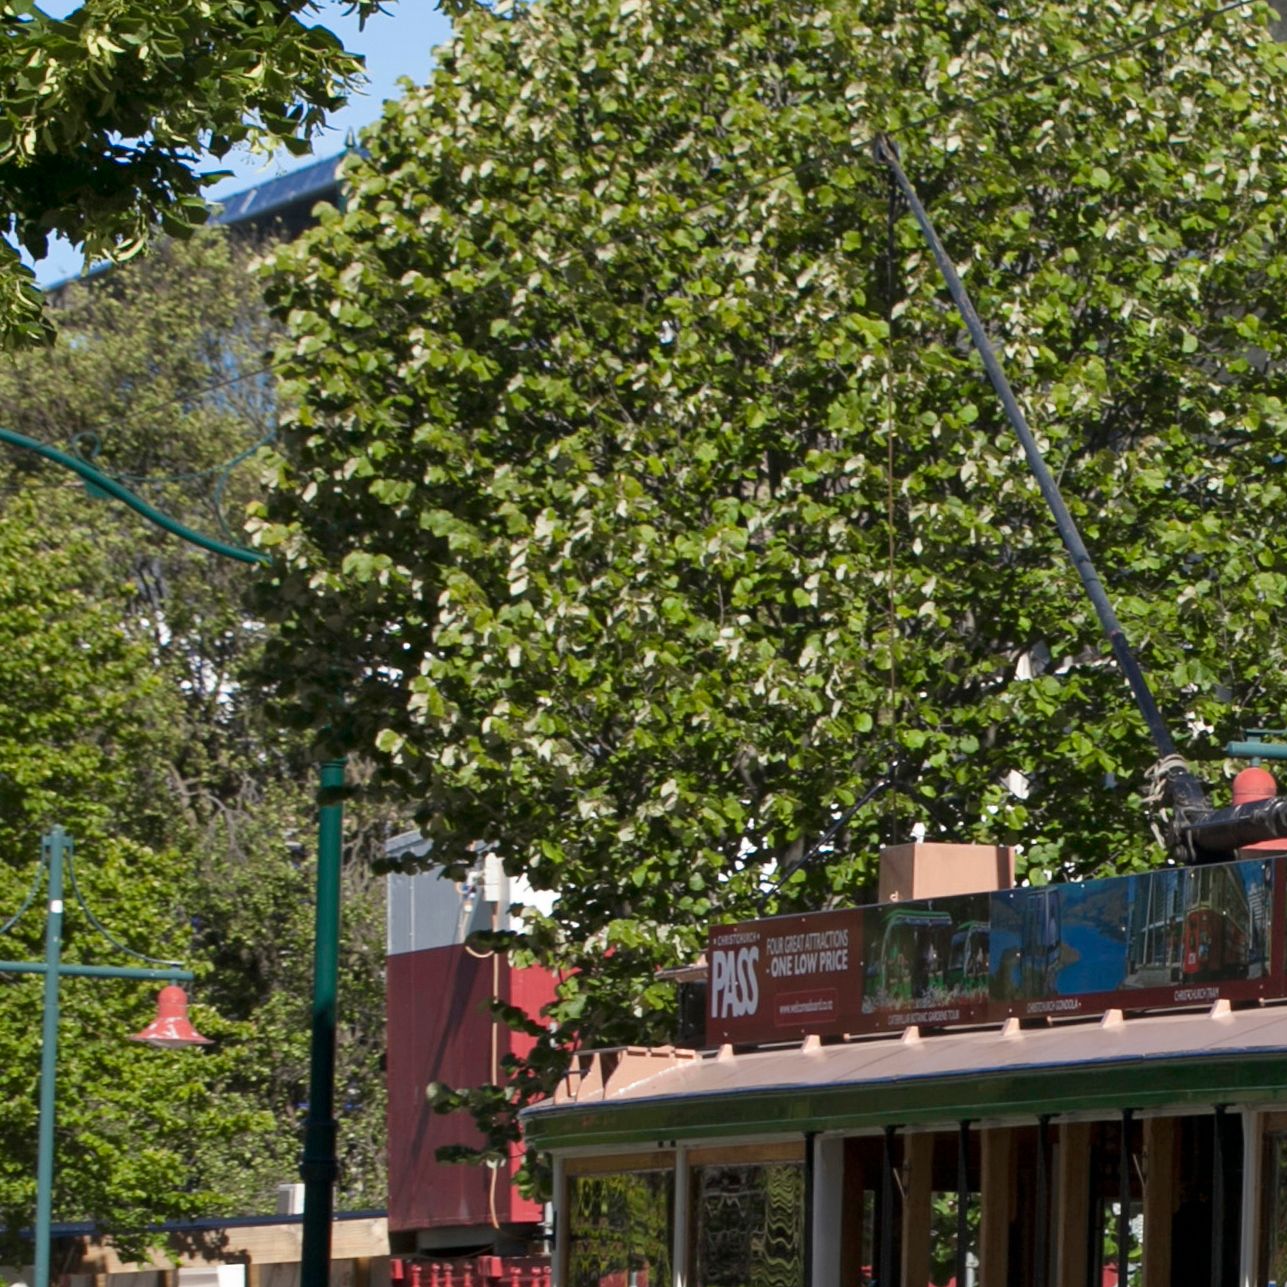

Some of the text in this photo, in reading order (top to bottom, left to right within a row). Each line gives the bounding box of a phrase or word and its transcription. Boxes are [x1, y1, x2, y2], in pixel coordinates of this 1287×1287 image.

[766, 929, 848, 954] FOUR GREAT ATTRACTIONS
[771, 955, 792, 979] ONE
[793, 953, 817, 976] LOW
[818, 950, 849, 973] PRICE
[711, 946, 760, 1020] PASS
